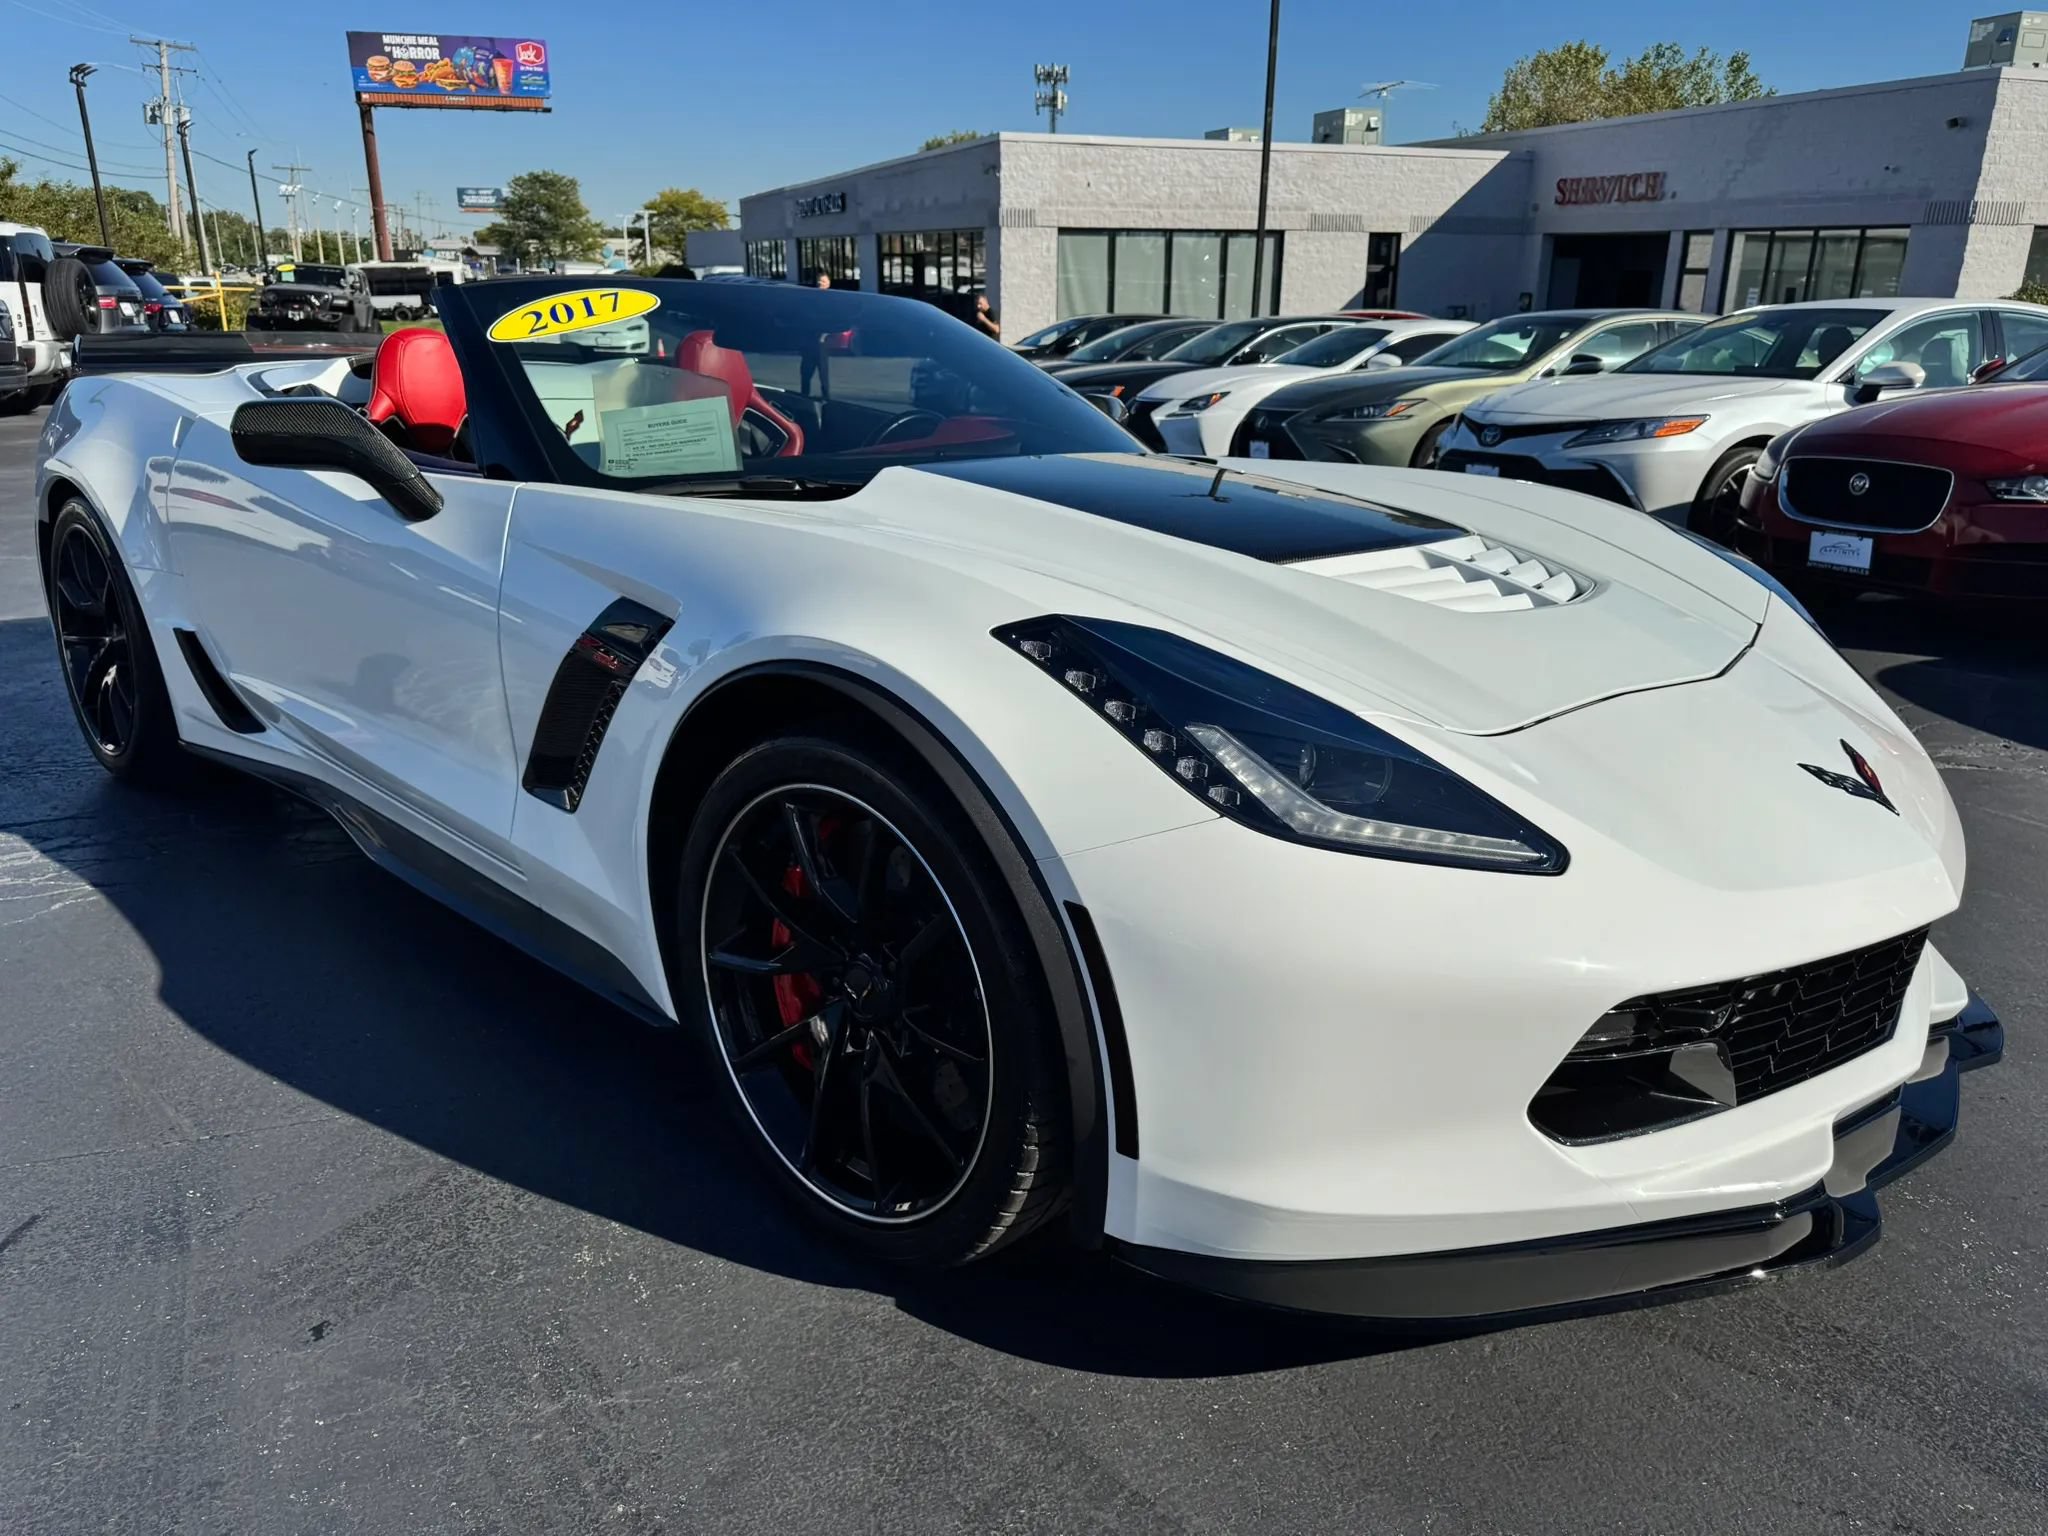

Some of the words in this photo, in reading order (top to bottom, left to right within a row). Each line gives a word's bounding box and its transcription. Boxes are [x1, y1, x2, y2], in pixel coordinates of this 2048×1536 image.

[382, 34, 417, 45] MUNCHIE
[417, 36, 439, 46] MEAL
[392, 45, 440, 60] HORROR
[1554, 172, 1666, 205] SERVICE
[521, 292, 619, 335] 2017
